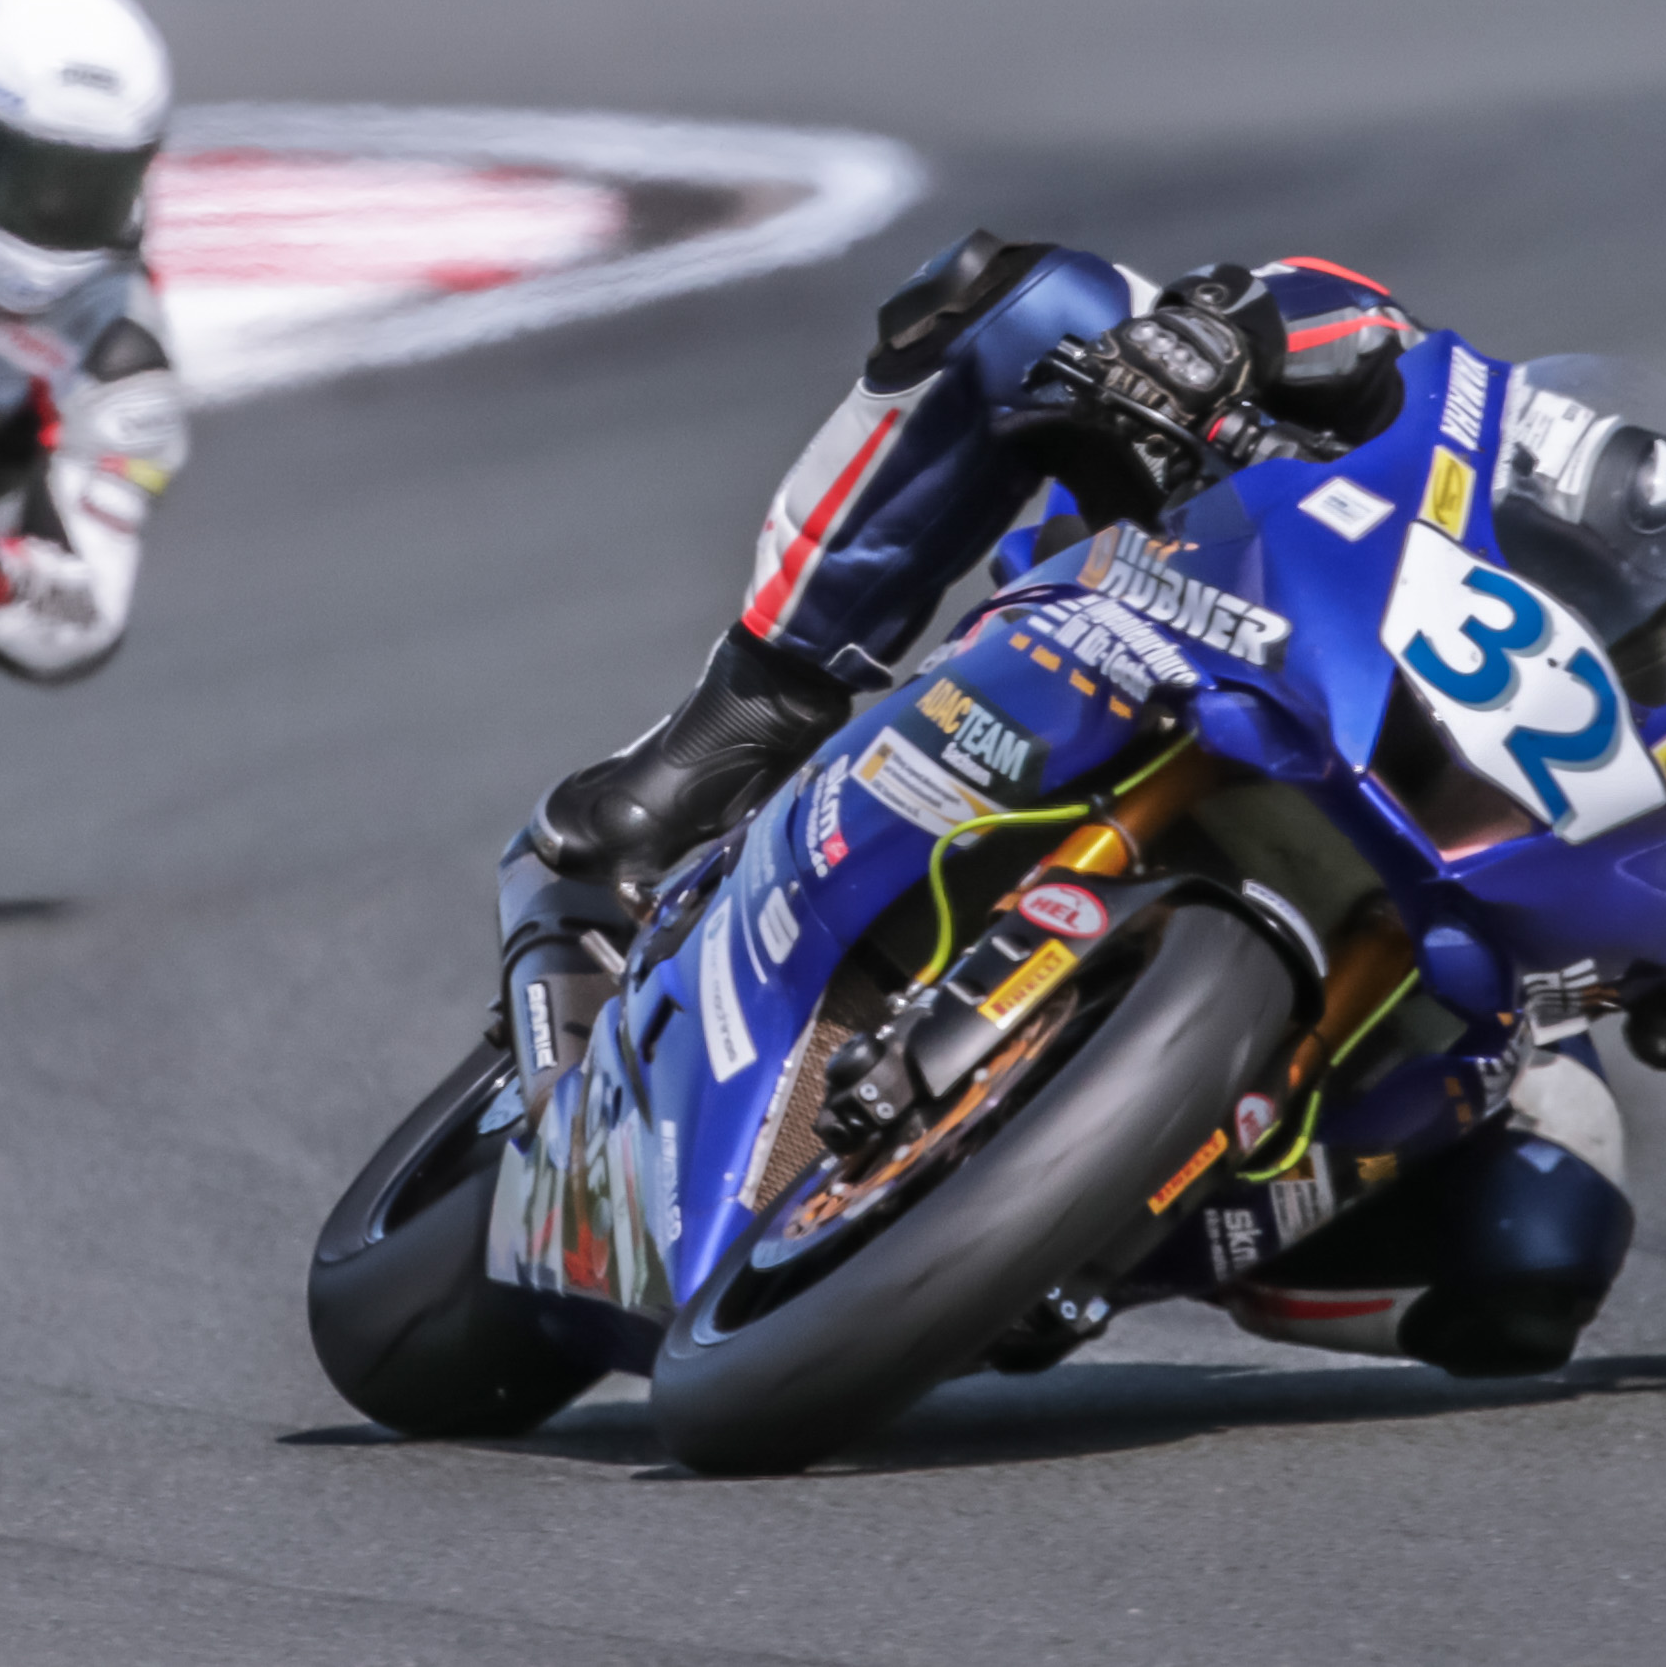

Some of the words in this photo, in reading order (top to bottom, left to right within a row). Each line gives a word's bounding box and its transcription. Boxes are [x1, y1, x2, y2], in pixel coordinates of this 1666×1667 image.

[1401, 565, 1623, 835] 32
[1029, 895, 1082, 930] HEL
[990, 948, 1066, 1018] PIRELLI
